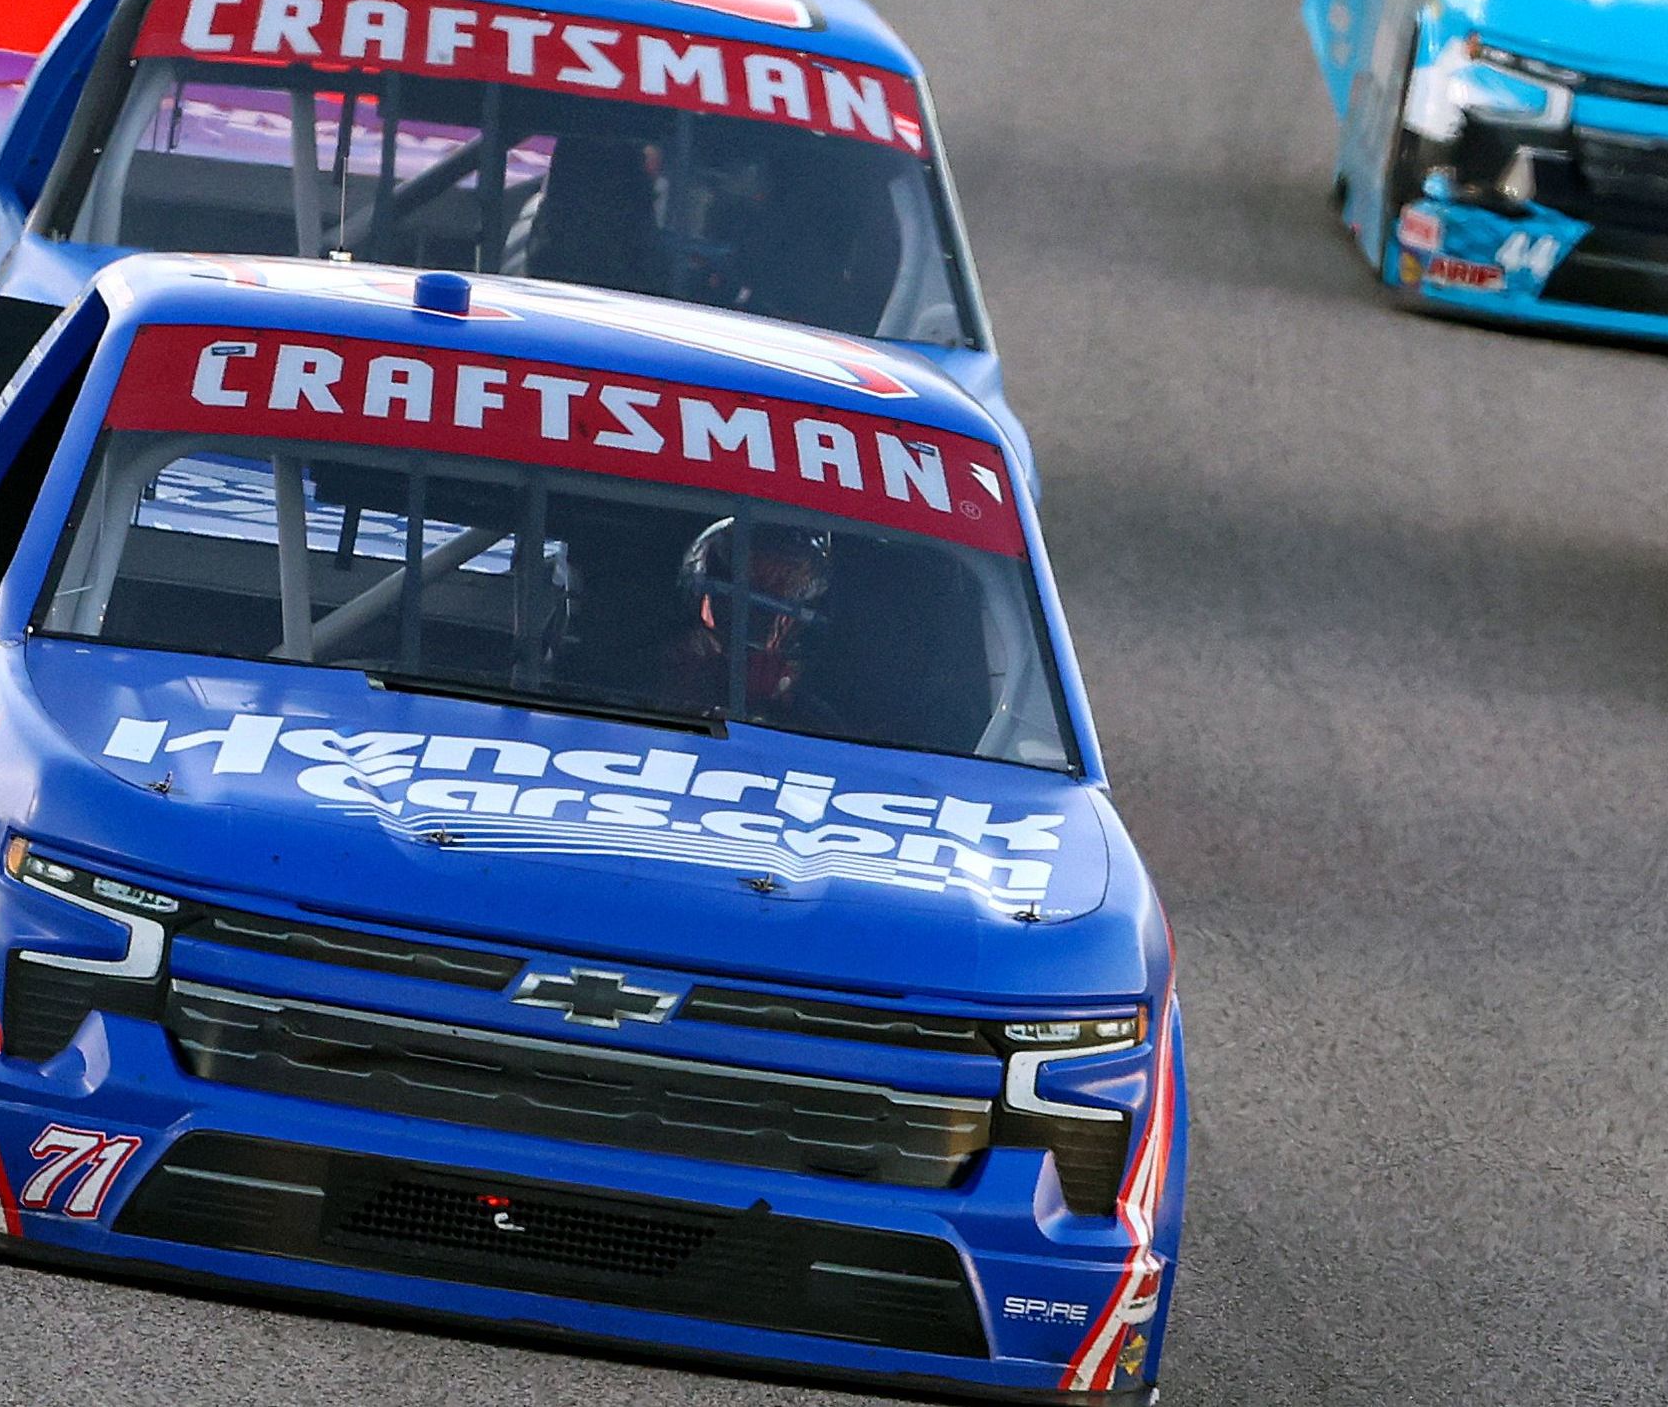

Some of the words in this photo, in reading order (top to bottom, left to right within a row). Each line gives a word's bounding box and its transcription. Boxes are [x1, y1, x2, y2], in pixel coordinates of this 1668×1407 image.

[1495, 231, 1561, 279] 44
[191, 341, 953, 513] CRAFTSMAN
[102, 712, 1066, 851] Hendrick
[297, 763, 1053, 914] Cars.com
[20, 1122, 142, 1220] 71
[1004, 1296, 1089, 1321] SPIRE
